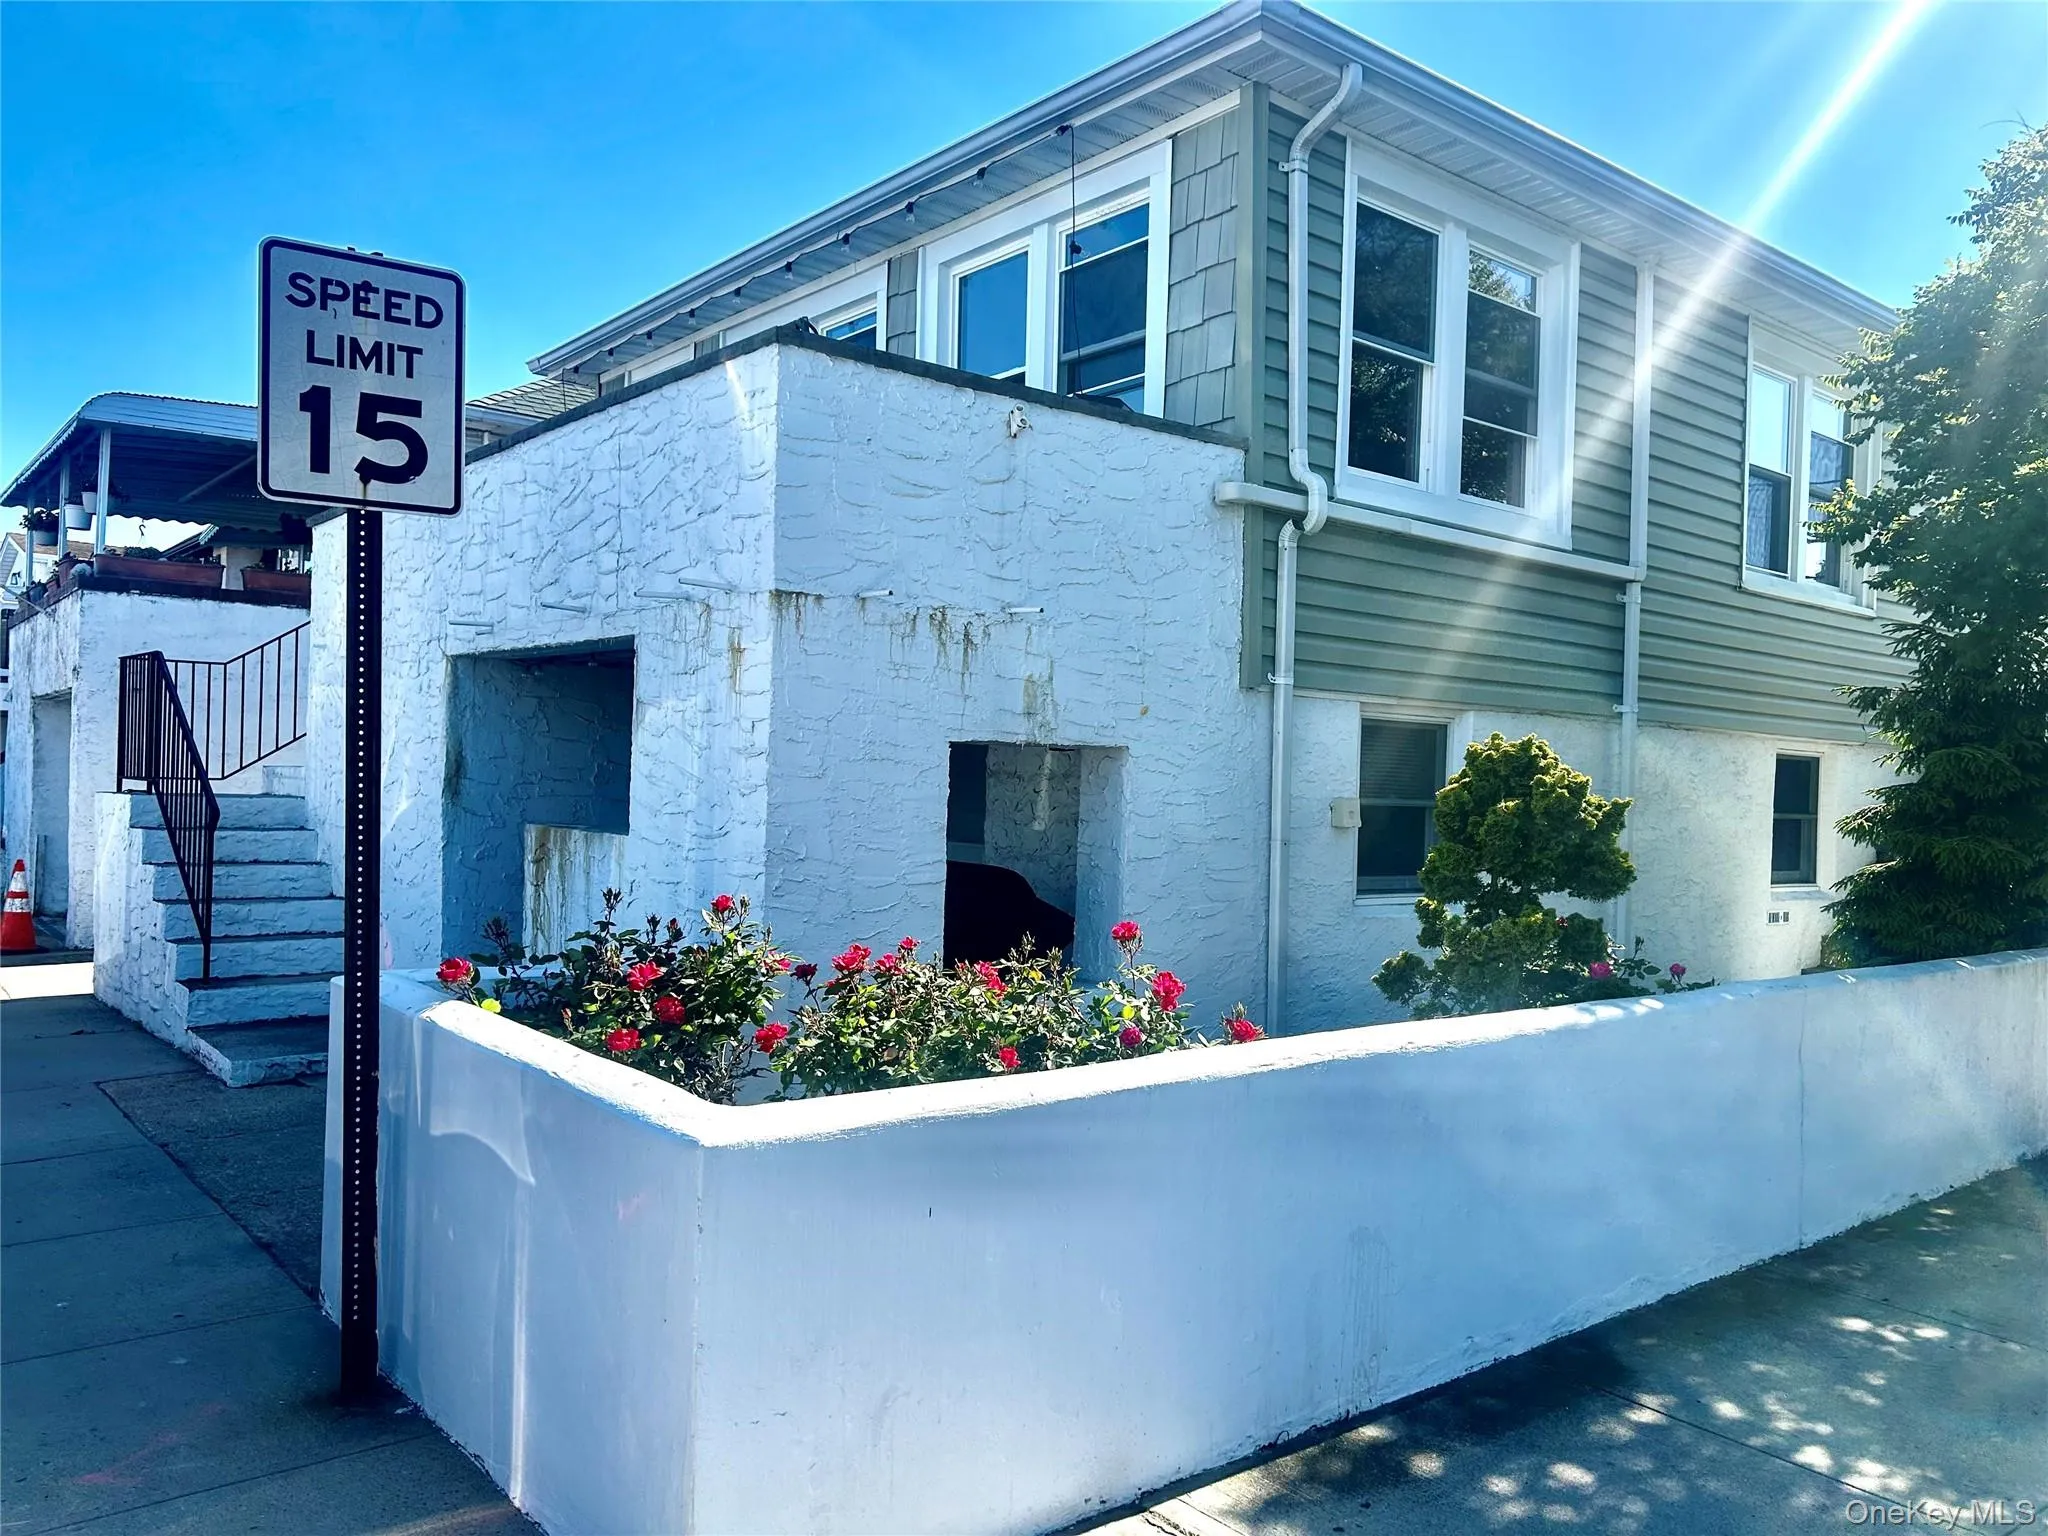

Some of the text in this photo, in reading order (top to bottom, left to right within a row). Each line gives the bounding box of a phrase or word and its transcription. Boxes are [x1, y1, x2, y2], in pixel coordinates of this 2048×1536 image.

[285, 272, 443, 329] SPEED
[306, 329, 423, 379] LIMIT
[299, 385, 428, 484] 15
